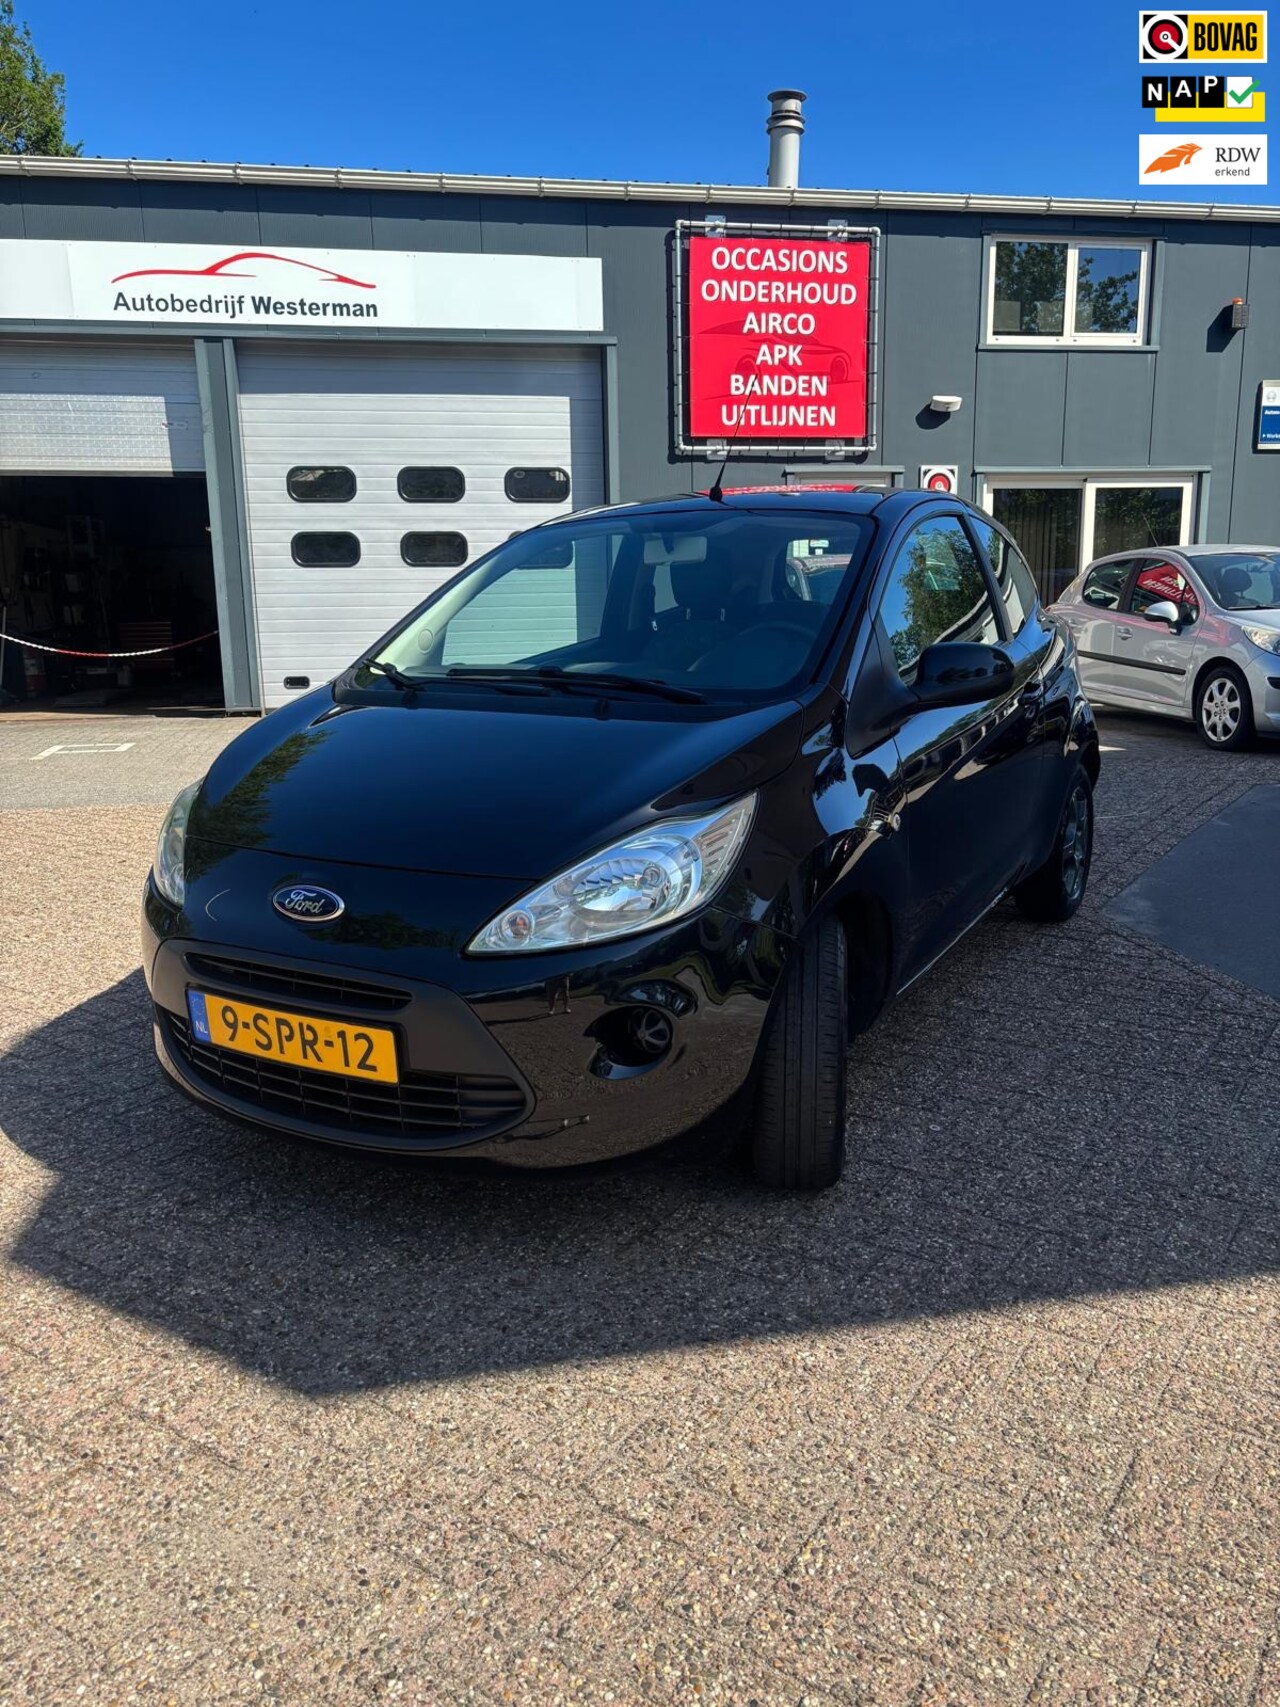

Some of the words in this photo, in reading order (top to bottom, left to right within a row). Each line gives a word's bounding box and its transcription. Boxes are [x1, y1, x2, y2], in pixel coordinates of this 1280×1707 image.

[711, 247, 849, 274] OCCASIONS
[701, 279, 858, 305] ONDERHOUD
[113, 292, 245, 318] Autobedrijf
[251, 296, 379, 318] Westerman
[742, 312, 816, 335] AIRCO
[756, 344, 803, 366] APK
[730, 374, 828, 397] BANDEN
[721, 404, 836, 427] UITLIJNEN
[285, 889, 326, 914] Ford
[195, 1020, 209, 1034] NL
[221, 1005, 378, 1073] 9-SPR-12
